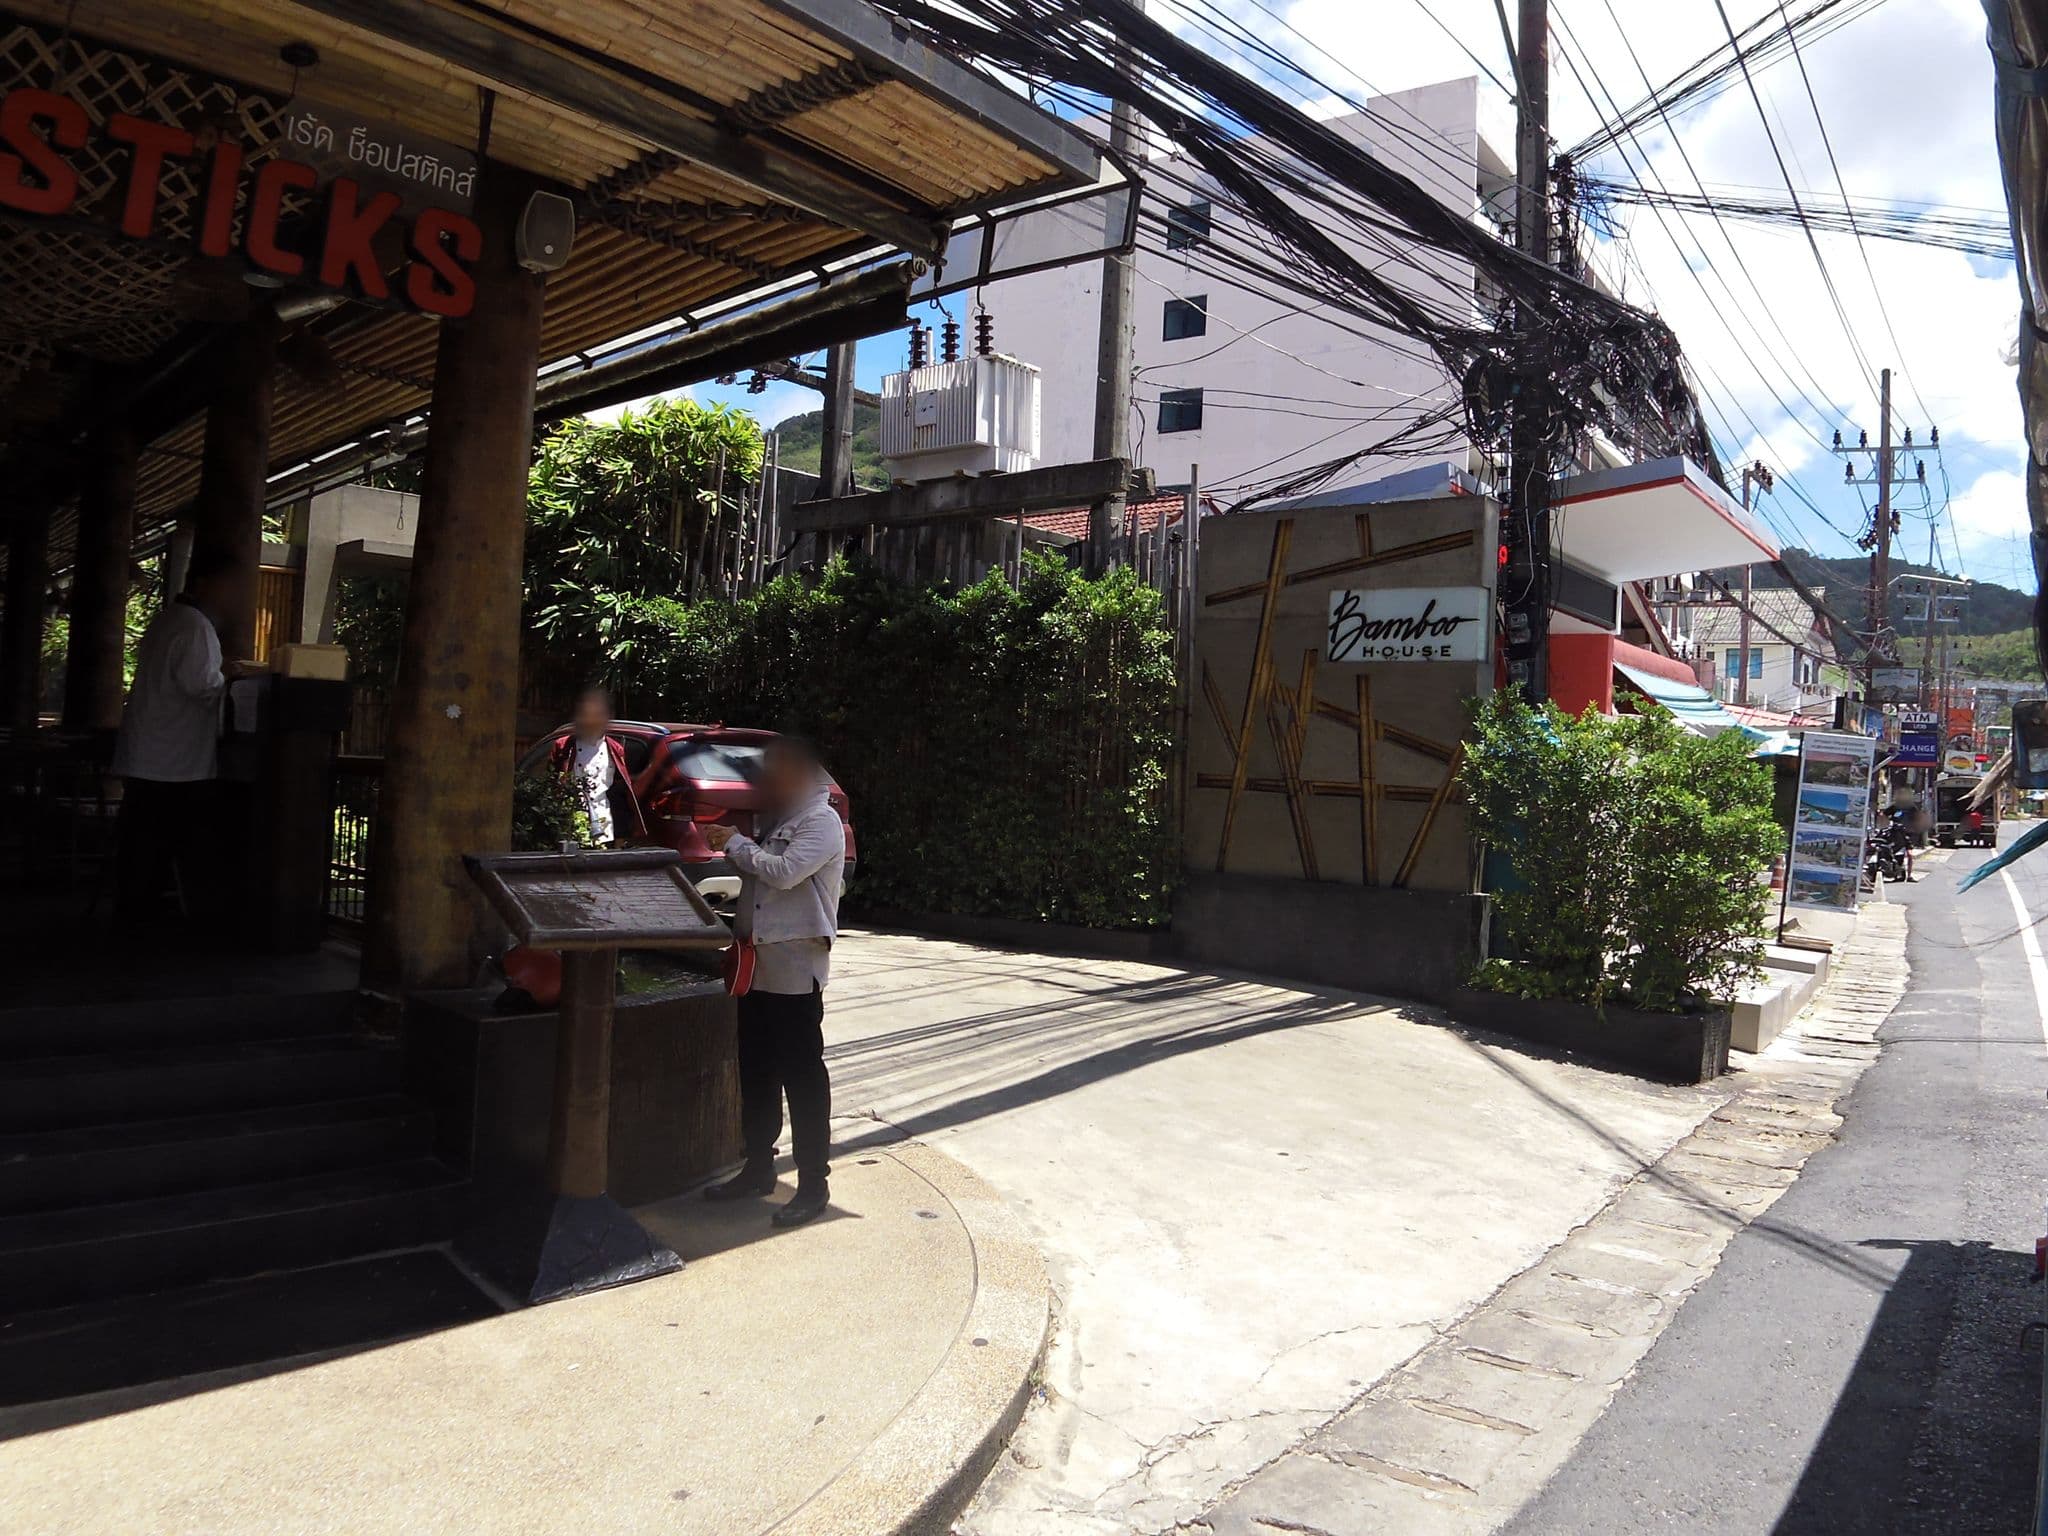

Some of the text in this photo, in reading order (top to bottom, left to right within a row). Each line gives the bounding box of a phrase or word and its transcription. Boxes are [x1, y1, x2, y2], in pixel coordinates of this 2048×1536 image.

[0, 87, 483, 318] STICKS
[1329, 590, 1480, 661] Bamboo
[1904, 713, 1930, 722] ATM
